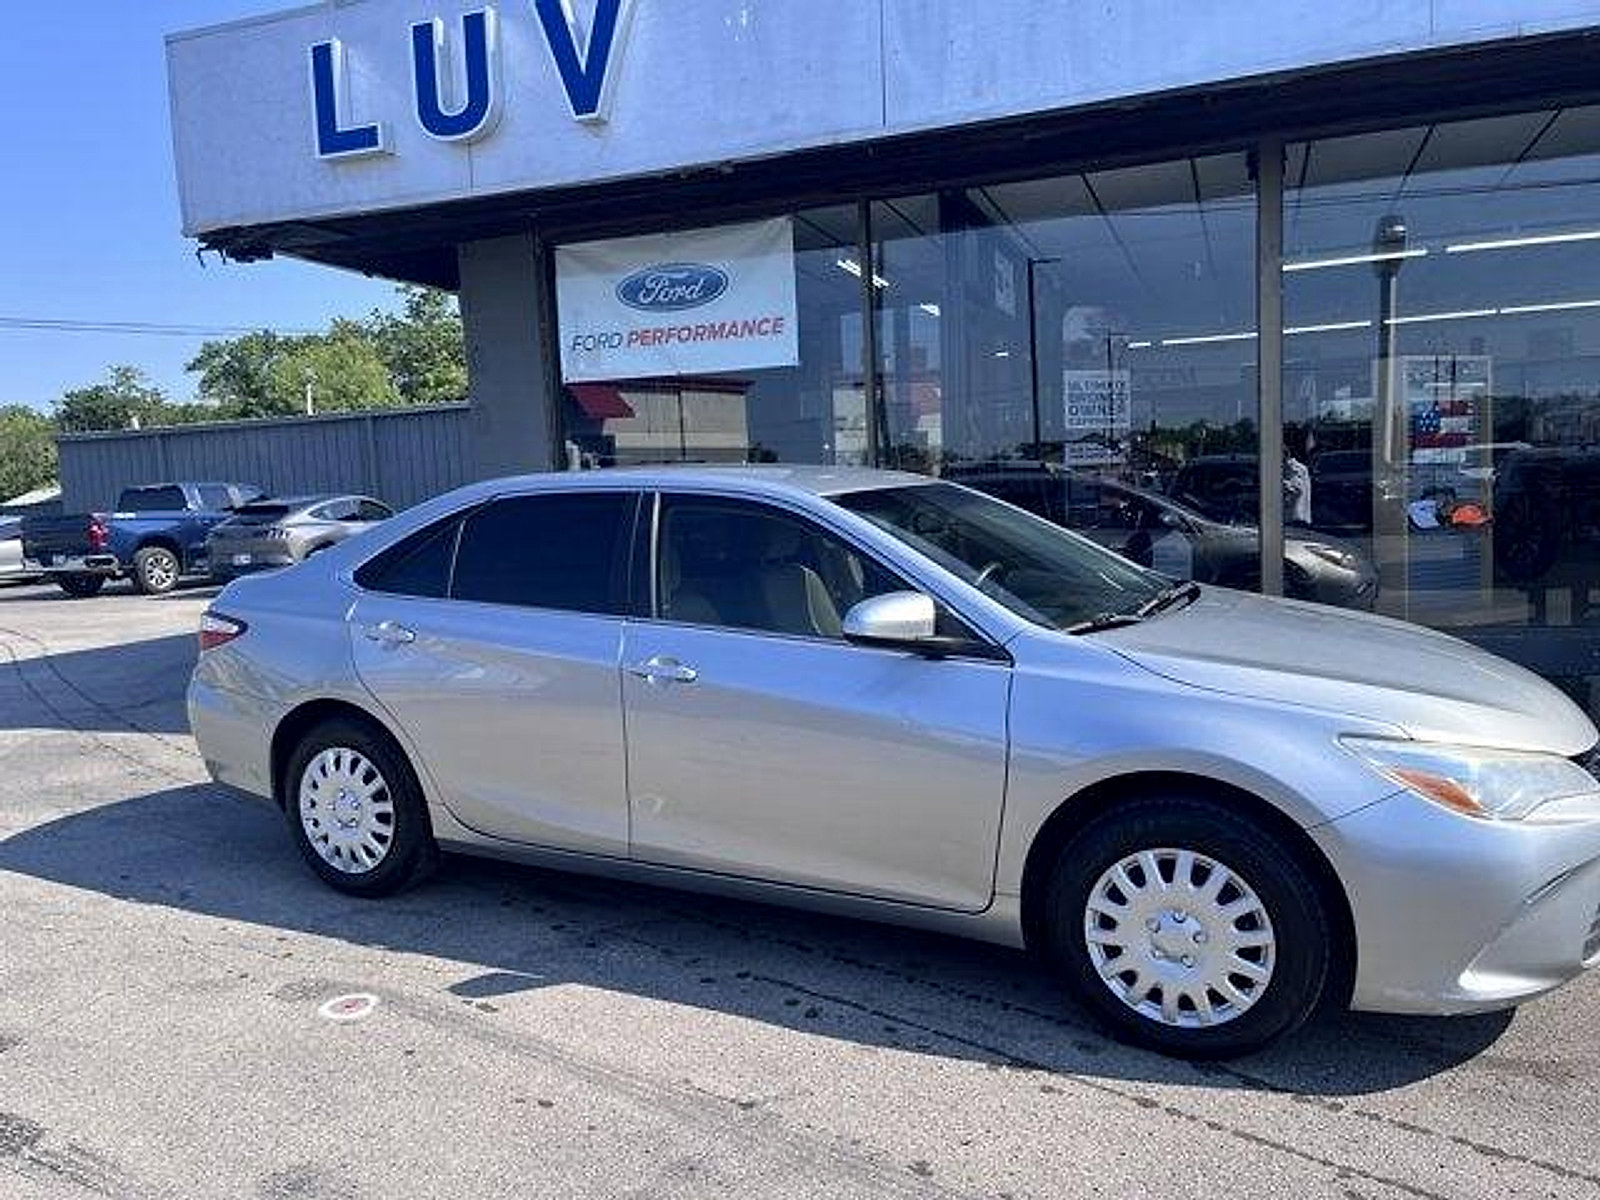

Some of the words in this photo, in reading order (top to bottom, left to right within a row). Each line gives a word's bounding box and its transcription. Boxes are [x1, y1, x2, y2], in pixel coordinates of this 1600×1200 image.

[639, 270, 705, 304] Ford
[572, 332, 623, 352] FORD
[627, 317, 785, 348] PERFORMANCE
